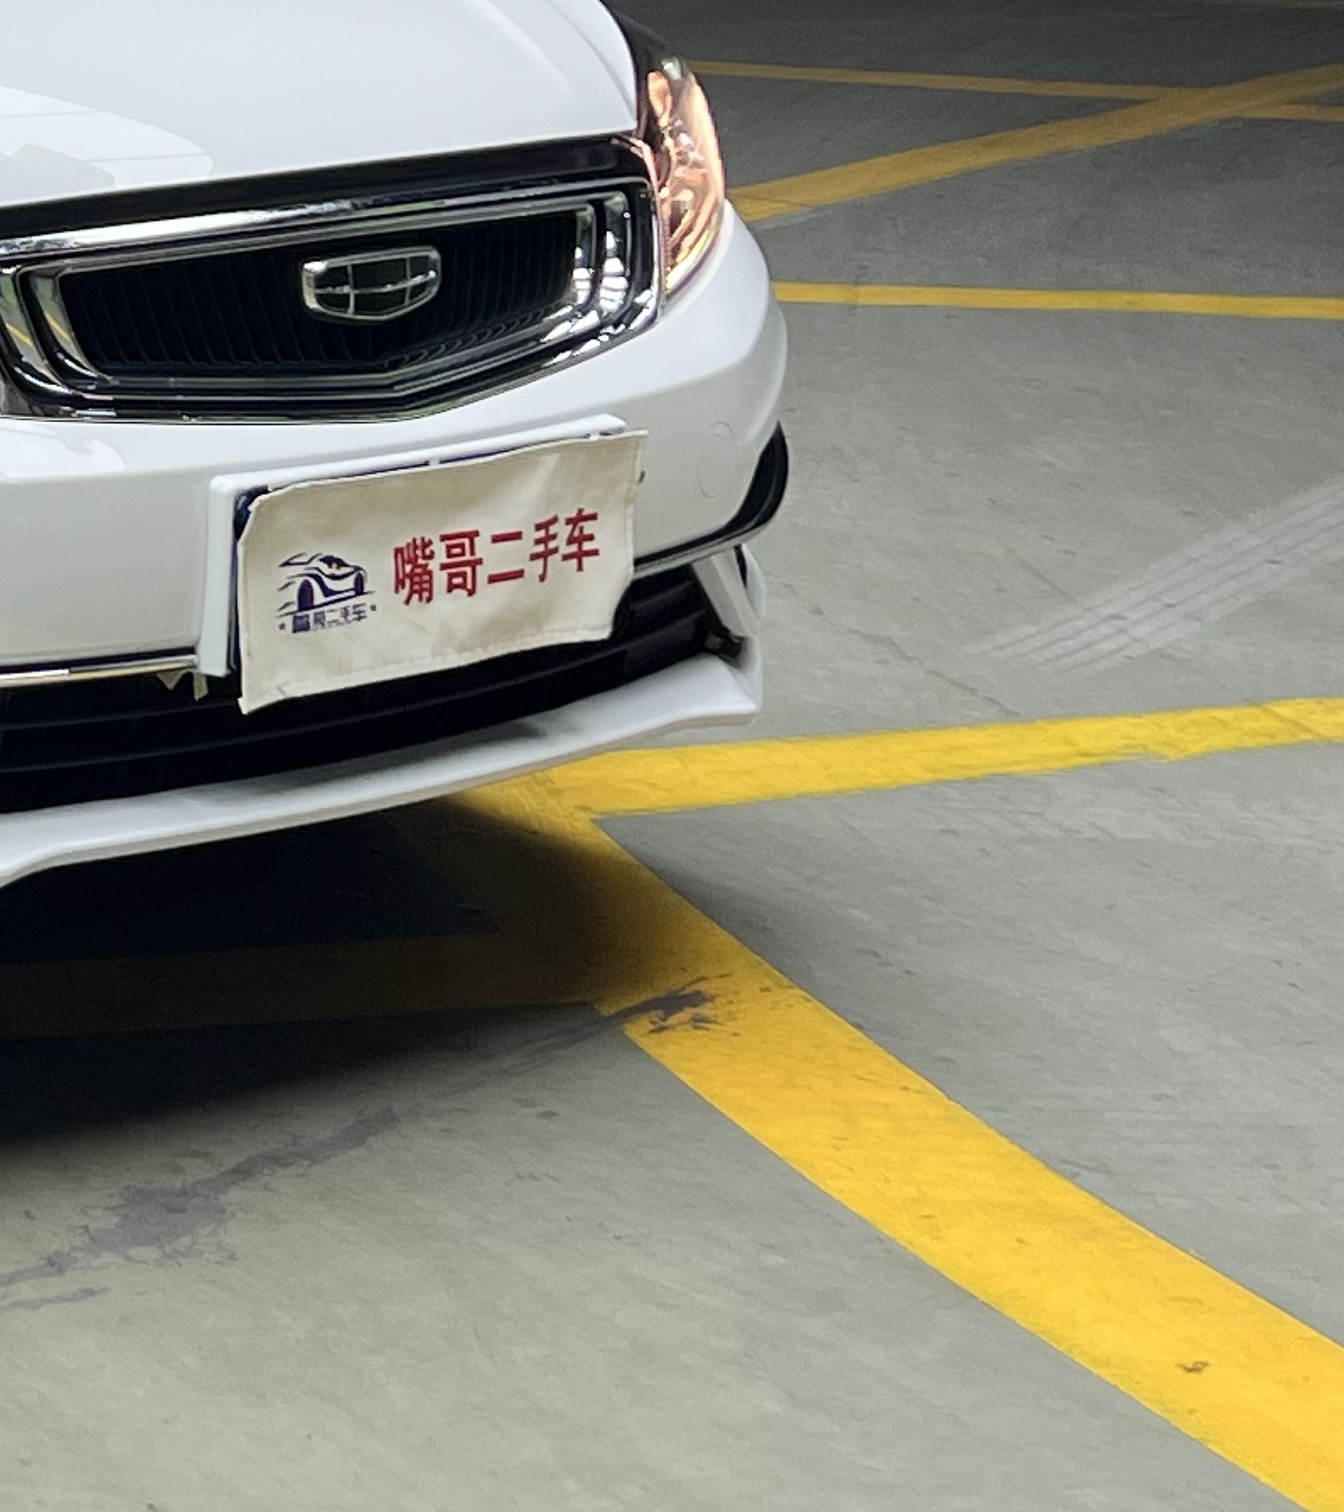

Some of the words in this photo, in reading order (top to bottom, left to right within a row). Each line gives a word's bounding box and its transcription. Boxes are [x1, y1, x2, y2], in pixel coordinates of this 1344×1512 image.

[393, 507, 600, 606] 嘴哥二手车
